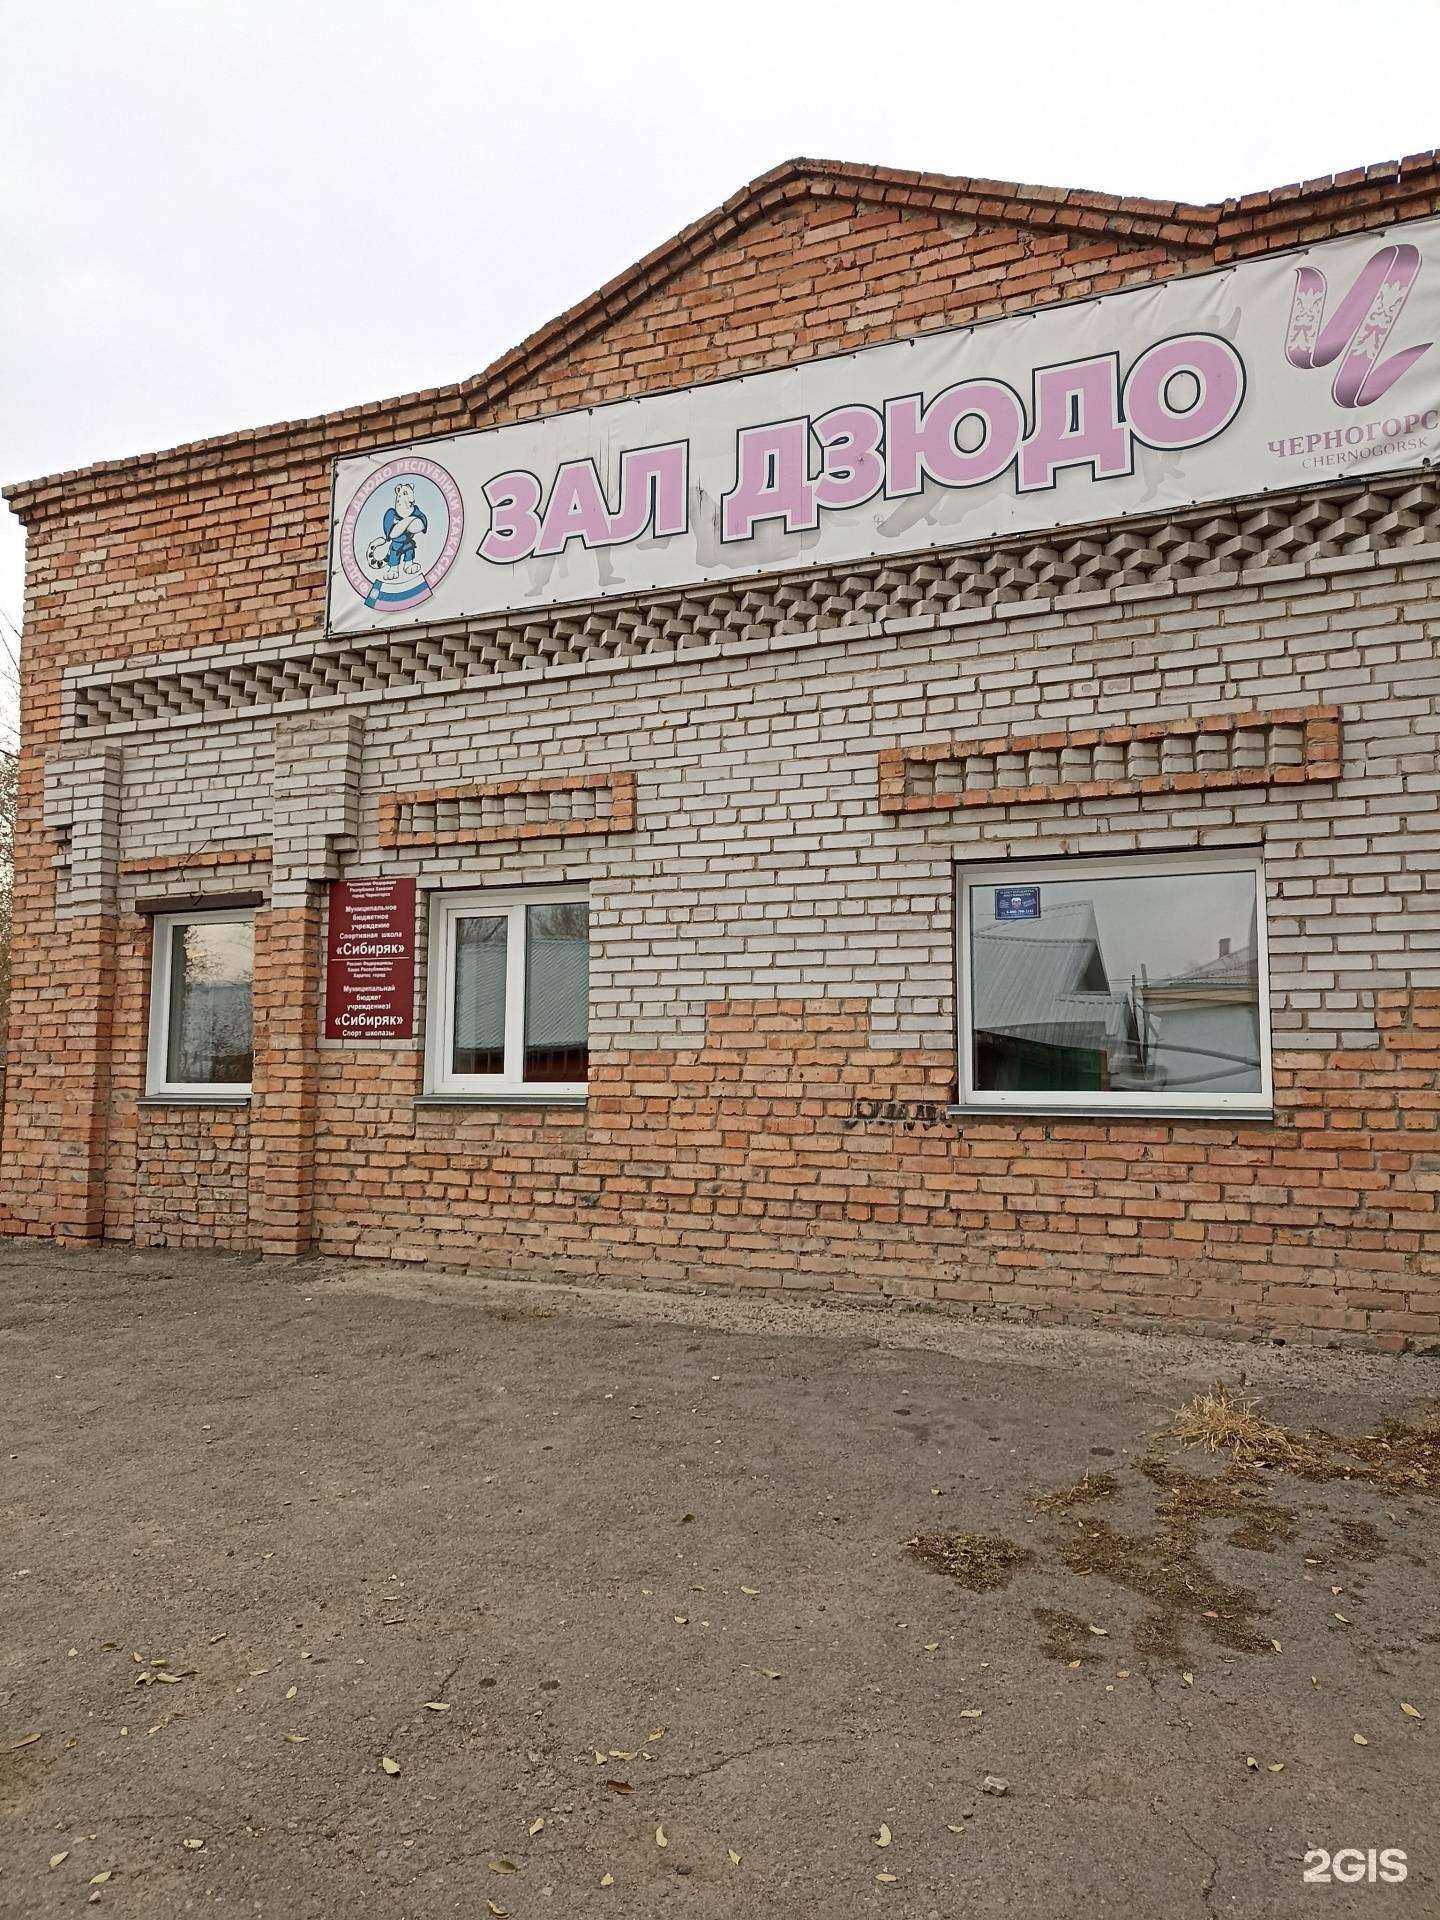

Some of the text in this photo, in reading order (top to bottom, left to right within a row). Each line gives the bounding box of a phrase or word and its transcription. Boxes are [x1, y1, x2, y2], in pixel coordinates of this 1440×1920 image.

[476, 332, 1248, 565] ЗАЛ ДЗЮДО
[1302, 437, 1429, 470] CHERNOGORSK
[345, 905, 397, 913] Муниципальное
[339, 932, 378, 940] Спортивная
[336, 942, 405, 957] «Сибиряк»
[356, 994, 382, 1002] бюджет
[334, 1013, 404, 1029] «Сибиряк»
